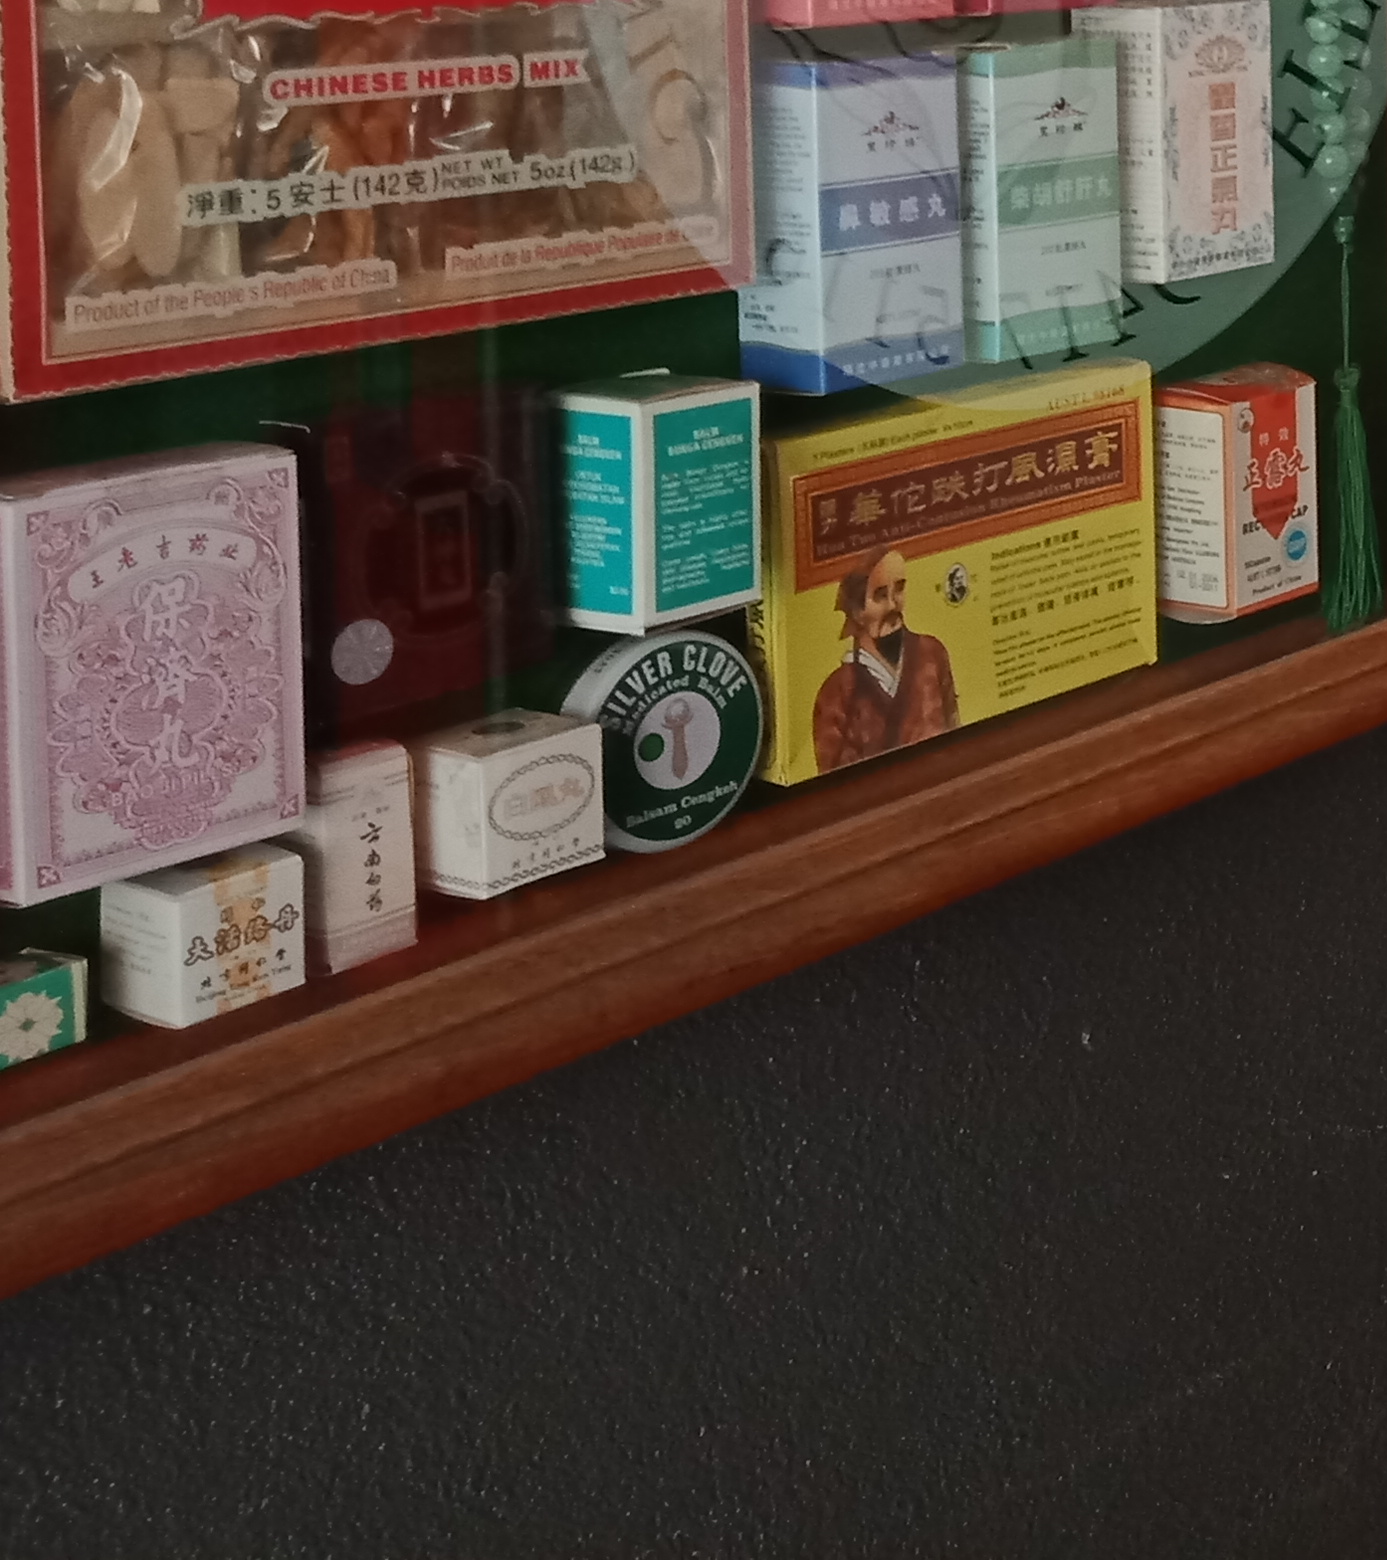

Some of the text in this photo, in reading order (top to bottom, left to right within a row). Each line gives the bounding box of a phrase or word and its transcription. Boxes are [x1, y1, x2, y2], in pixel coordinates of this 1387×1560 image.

[269, 58, 585, 100] CHINESE HERBS MIX
[440, 156, 504, 174] NET WT
[490, 170, 521, 186] NET
[73, 299, 140, 324] Product
[142, 296, 160, 316] of
[163, 294, 189, 313] the
[263, 278, 328, 302] Republic
[331, 272, 347, 291] of
[350, 267, 391, 290] China
[991, 541, 1042, 561] Indications
[602, 643, 748, 730] SILVER CLOVE
[626, 803, 679, 829] Balsam
